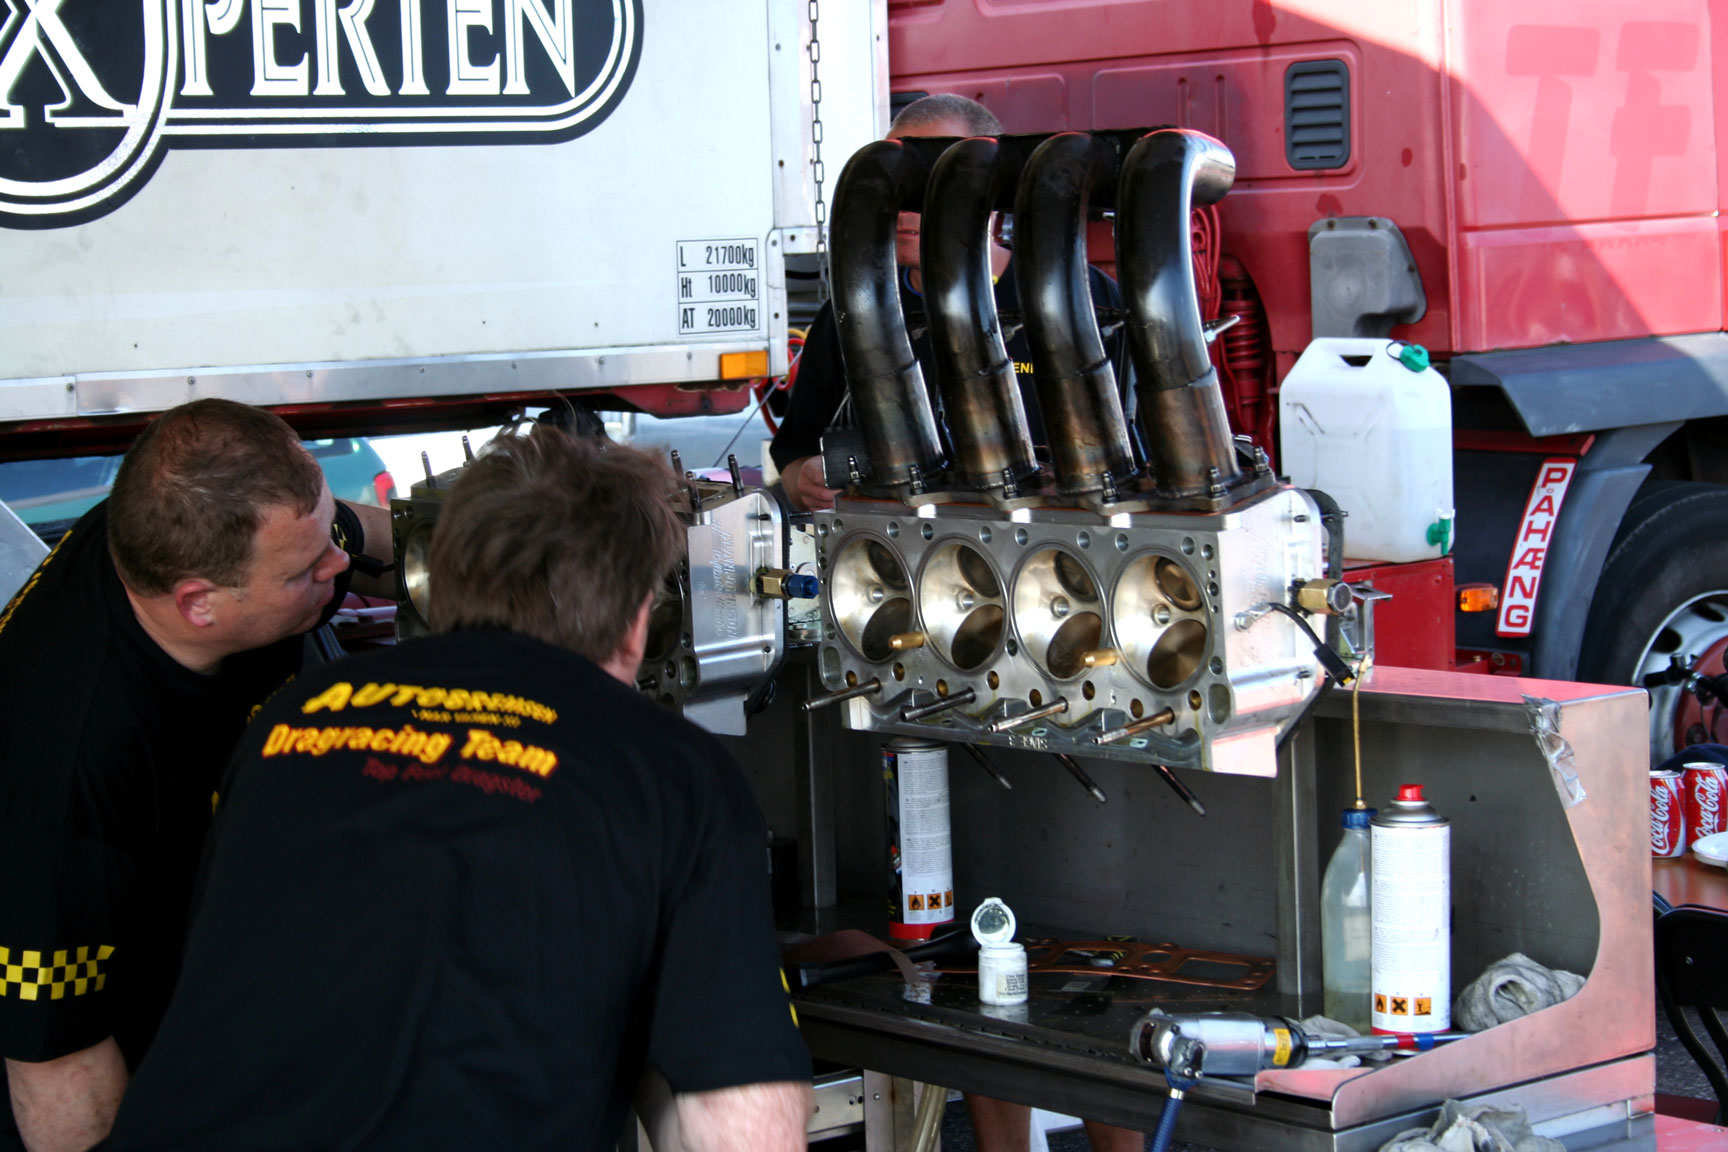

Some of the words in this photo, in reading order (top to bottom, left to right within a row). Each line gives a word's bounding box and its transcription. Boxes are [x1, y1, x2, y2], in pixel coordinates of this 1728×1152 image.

[680, 245, 686, 267] L
[706, 244, 754, 268] 21700kg
[708, 273, 756, 298] 10000kg
[682, 307, 696, 329] AT
[707, 305, 756, 329] 20000kg
[262, 723, 453, 764] Dragracing
[460, 728, 558, 779] Team
